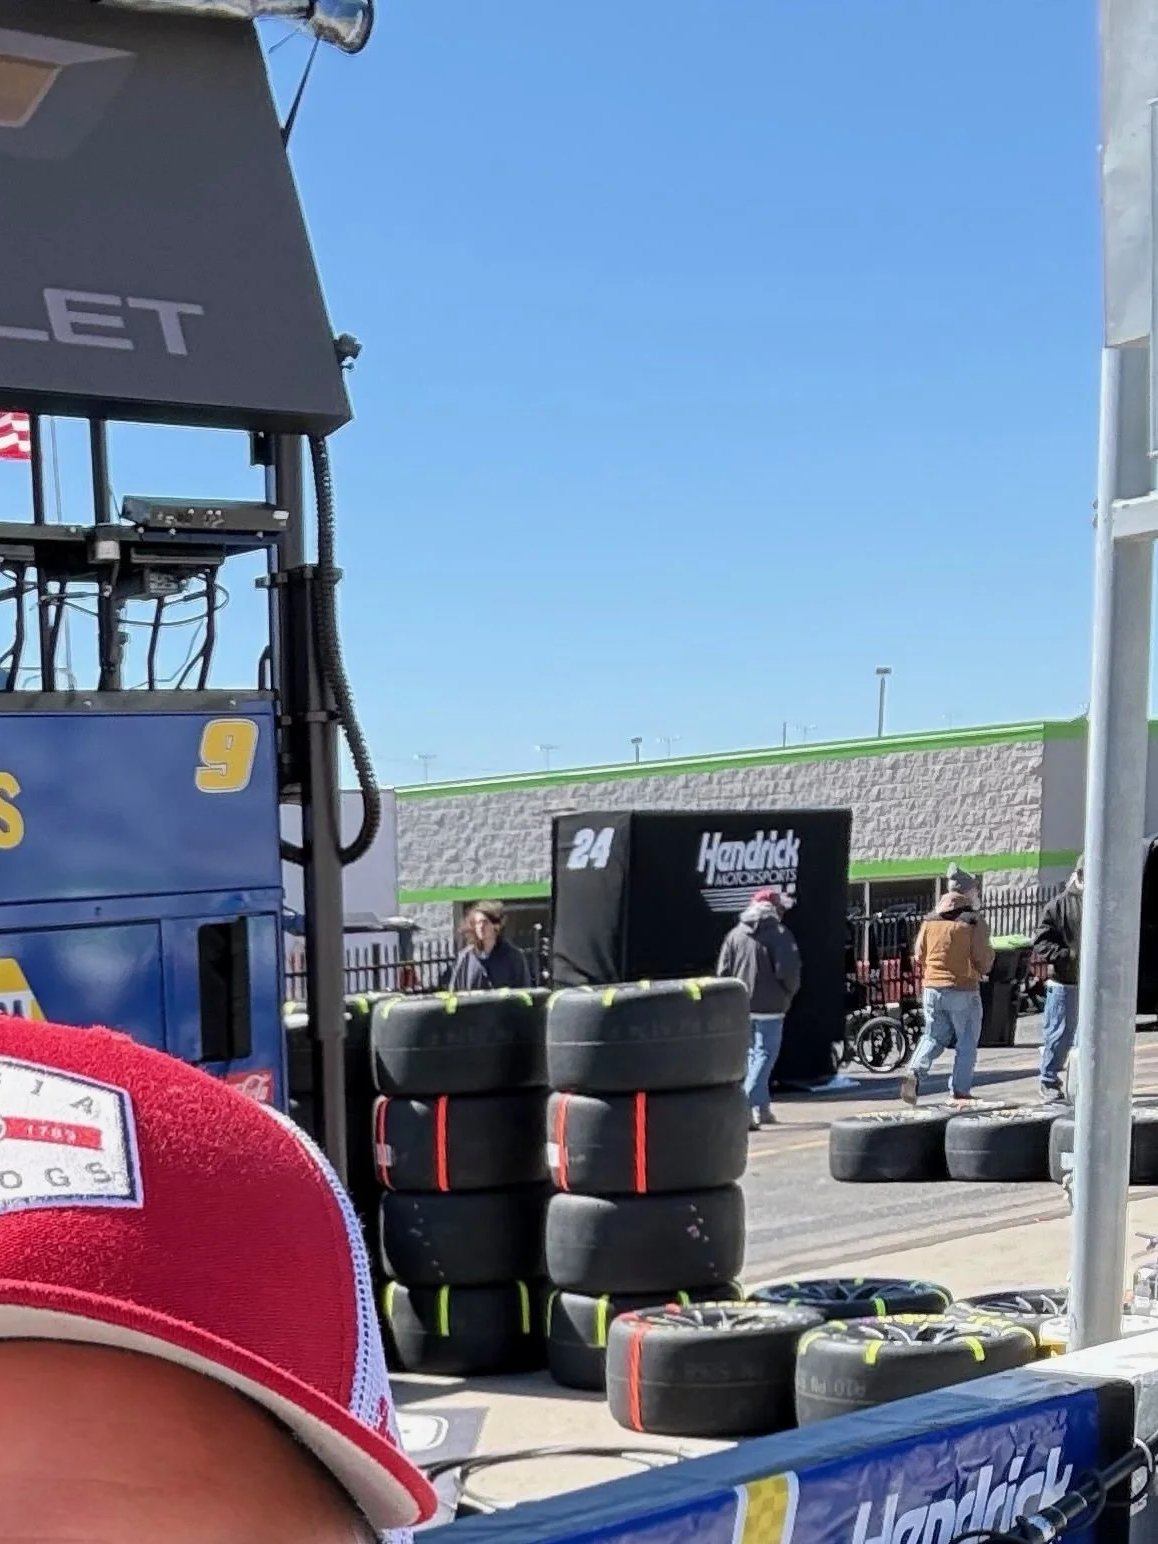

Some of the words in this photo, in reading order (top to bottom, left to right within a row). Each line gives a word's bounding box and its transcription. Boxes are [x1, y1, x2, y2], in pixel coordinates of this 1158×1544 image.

[195, 718, 259, 793] 9
[566, 827, 615, 871] 24
[698, 829, 801, 886] Hendrick
[714, 867, 797, 886] MOTORSPORTS
